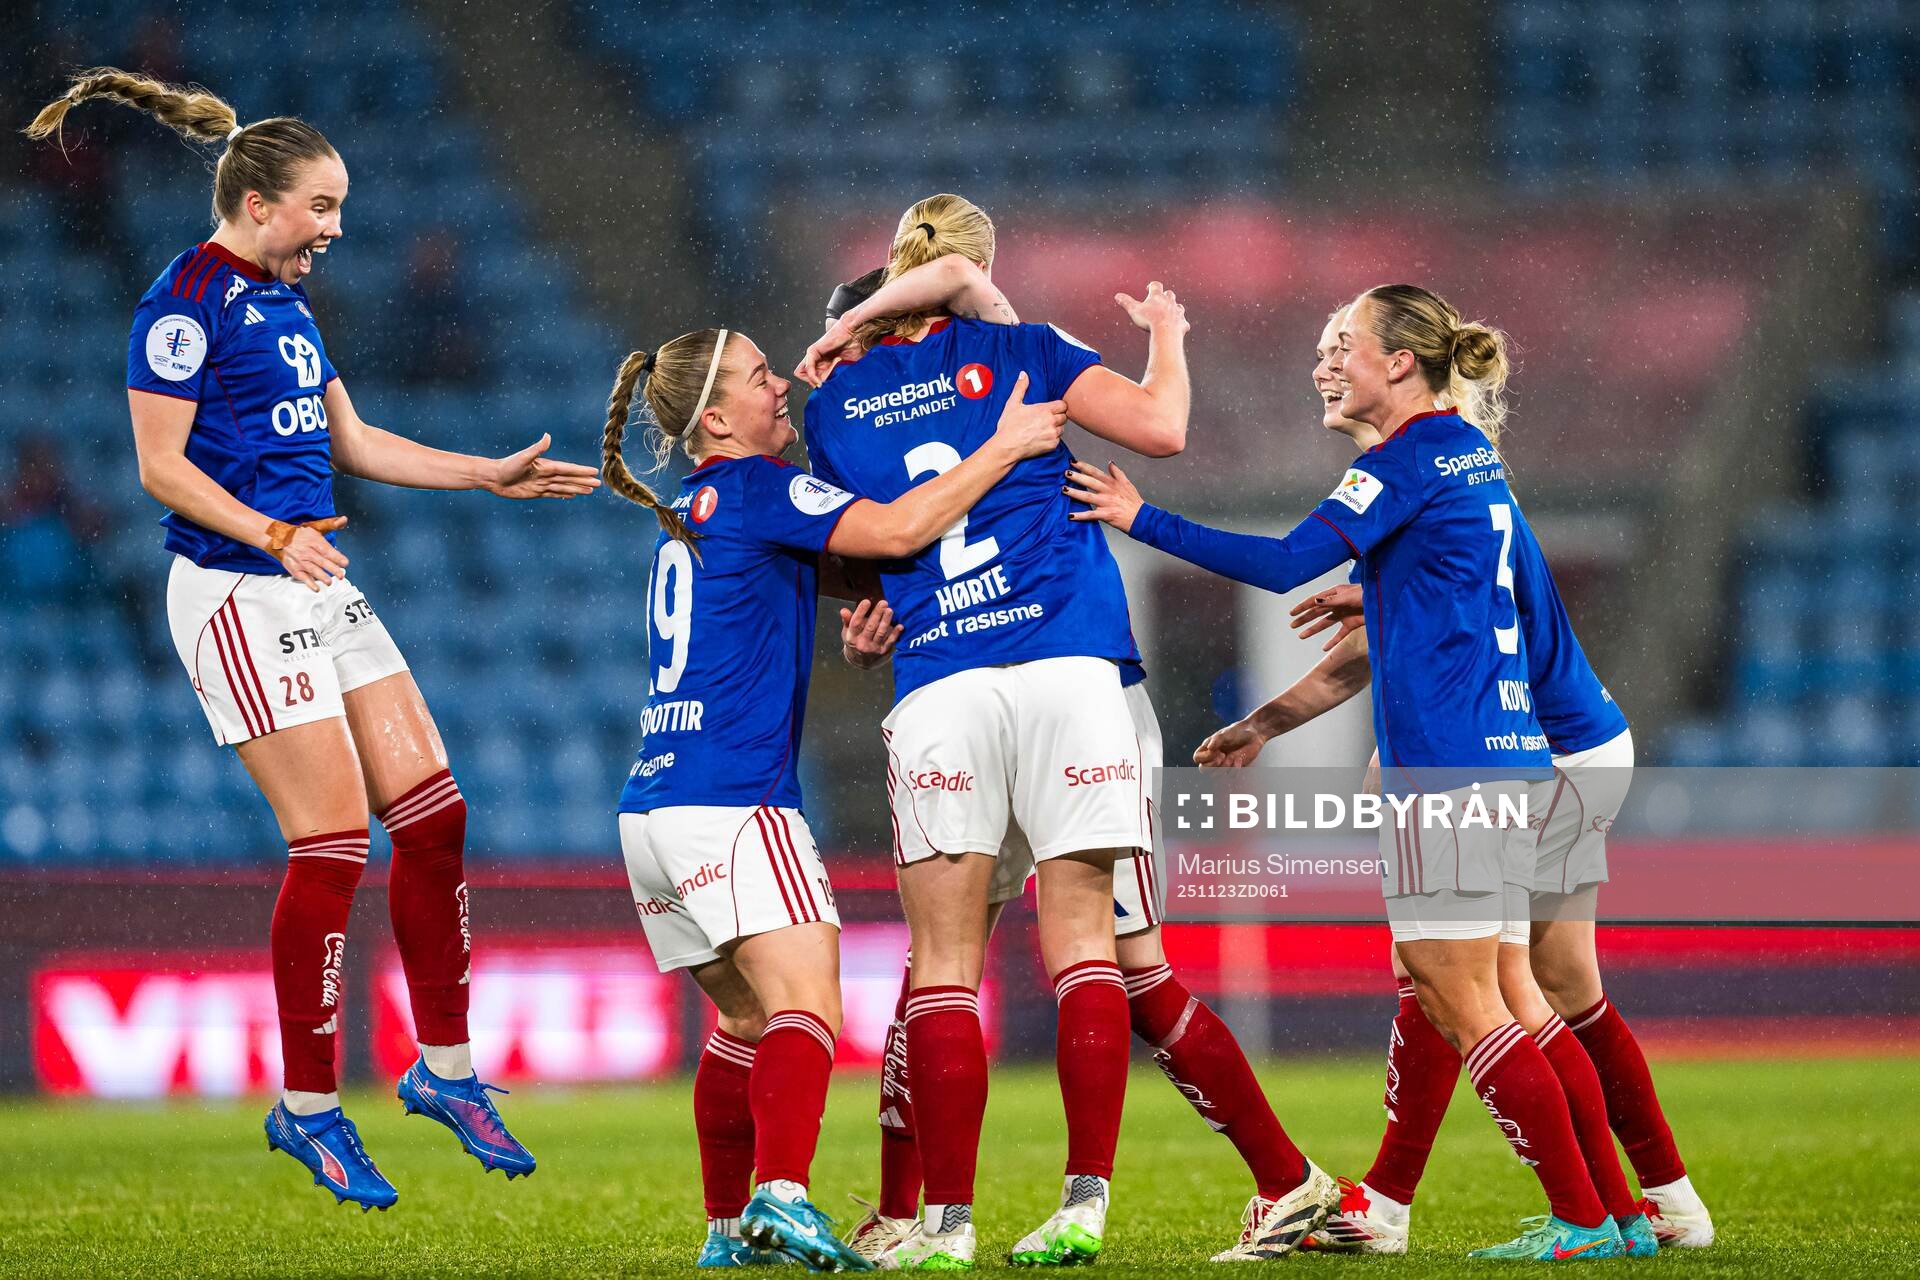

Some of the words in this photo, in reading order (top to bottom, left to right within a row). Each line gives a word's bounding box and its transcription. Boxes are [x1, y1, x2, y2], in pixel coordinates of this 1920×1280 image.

[843, 372, 955, 420] SpareBank
[964, 368, 983, 393] 1
[874, 395, 957, 428] ØSTLANDET
[904, 441, 1000, 580] 2
[935, 565, 1012, 616] HØRTE
[909, 619, 949, 649] mot
[956, 603, 1044, 636] rasisme
[279, 671, 315, 706] 28
[1485, 731, 1519, 751] mot
[1064, 759, 1136, 787] Scandic
